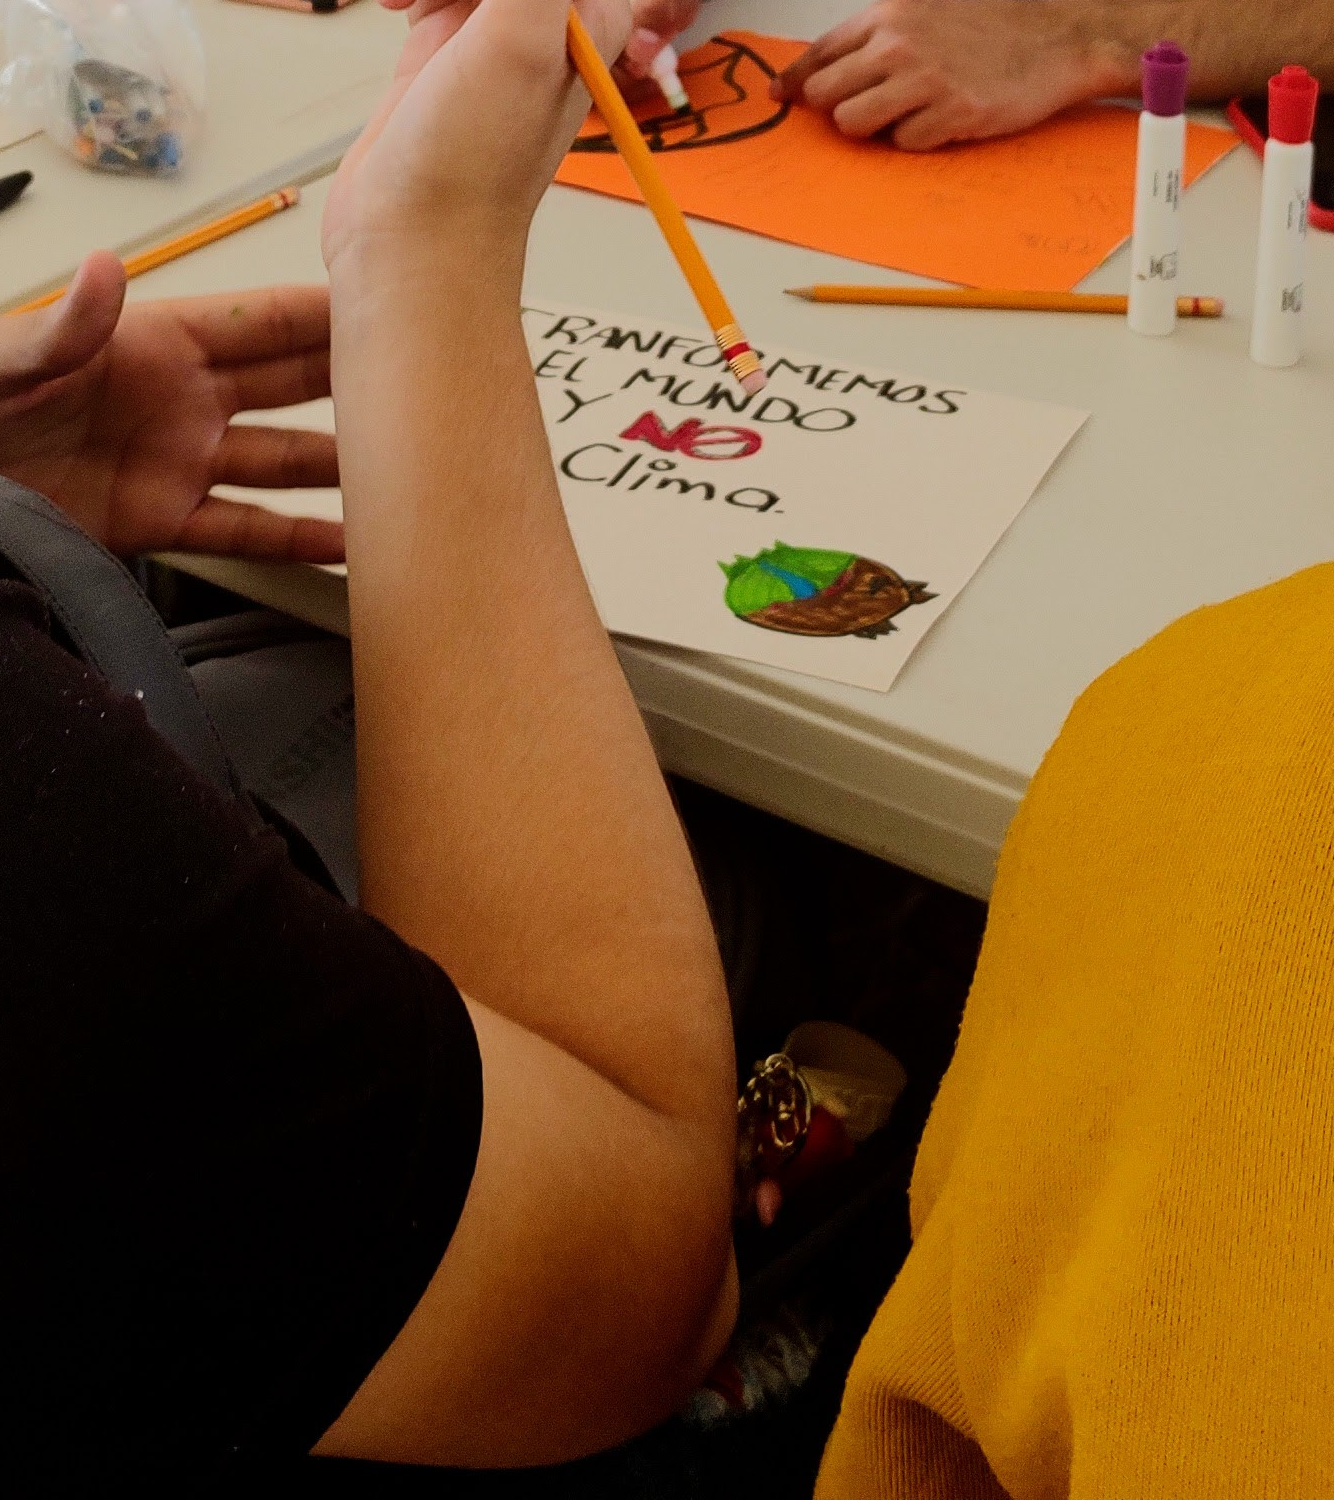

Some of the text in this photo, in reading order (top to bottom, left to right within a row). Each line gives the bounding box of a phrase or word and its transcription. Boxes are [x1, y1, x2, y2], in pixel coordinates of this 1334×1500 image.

[535, 349, 857, 432] EL MUNDO
[556, 389, 763, 461] Y NO
